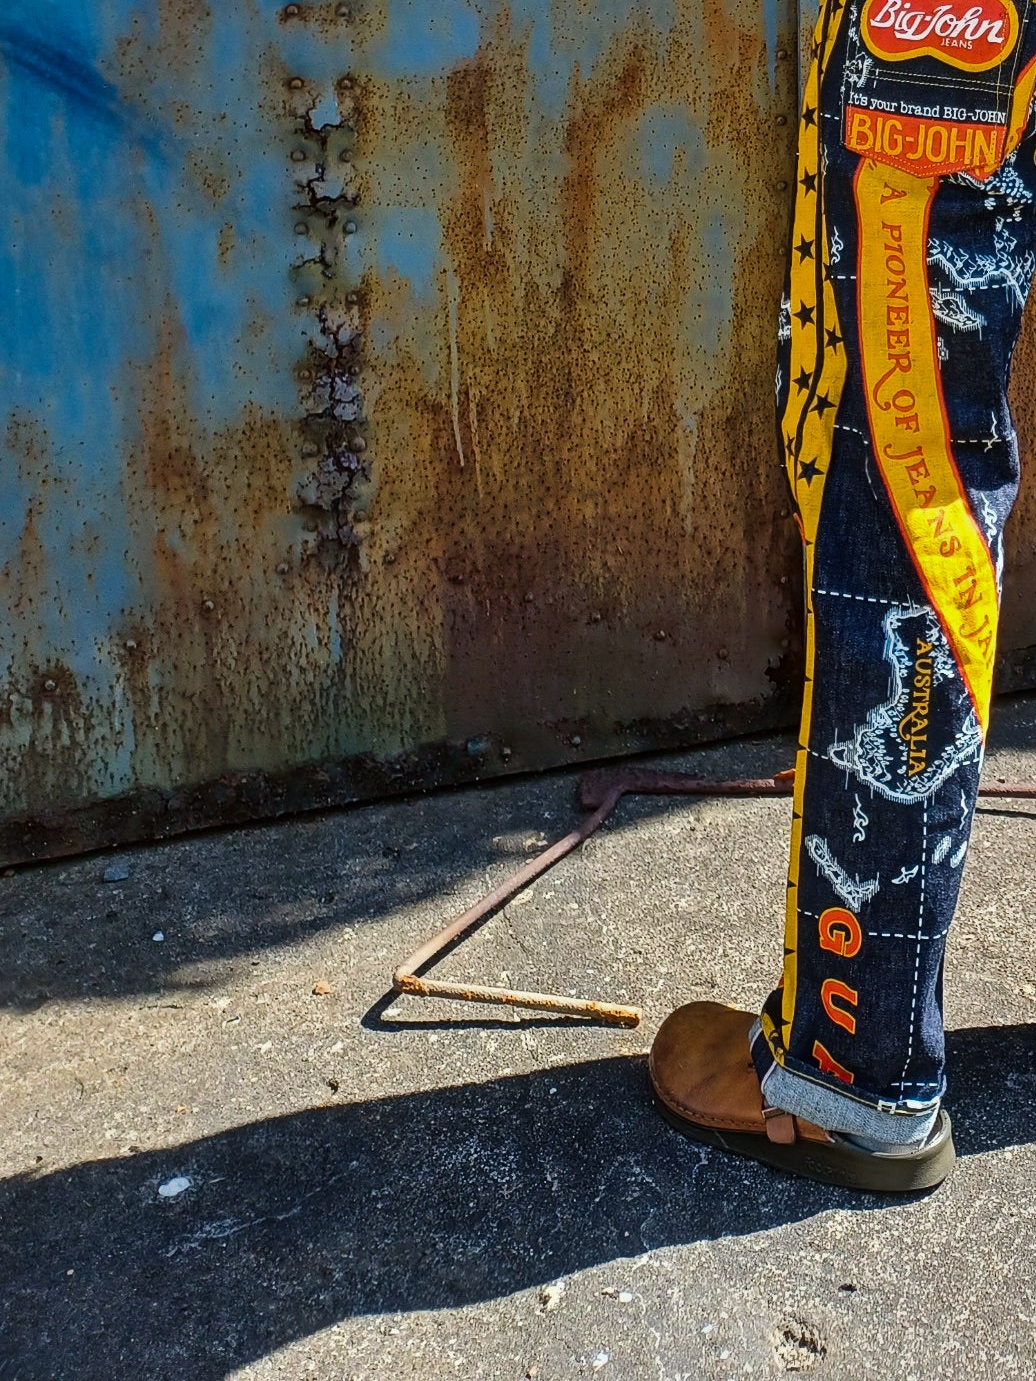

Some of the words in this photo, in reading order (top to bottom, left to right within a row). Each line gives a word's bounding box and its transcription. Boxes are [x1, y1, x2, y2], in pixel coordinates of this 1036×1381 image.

[940, 39, 973, 50] JEANS
[848, 92, 868, 106] It's
[869, 98, 898, 113] your
[900, 101, 940, 118] brand
[943, 108, 1006, 124] BIG-JOHN
[850, 113, 997, 167] BIG-JOHN
[880, 182, 907, 205] A
[873, 221, 912, 411] PIONEER
[892, 389, 921, 434] OF
[883, 443, 962, 558] JEANS
[953, 565, 982, 609] IN
[899, 638, 933, 777] AUSTRALIA
